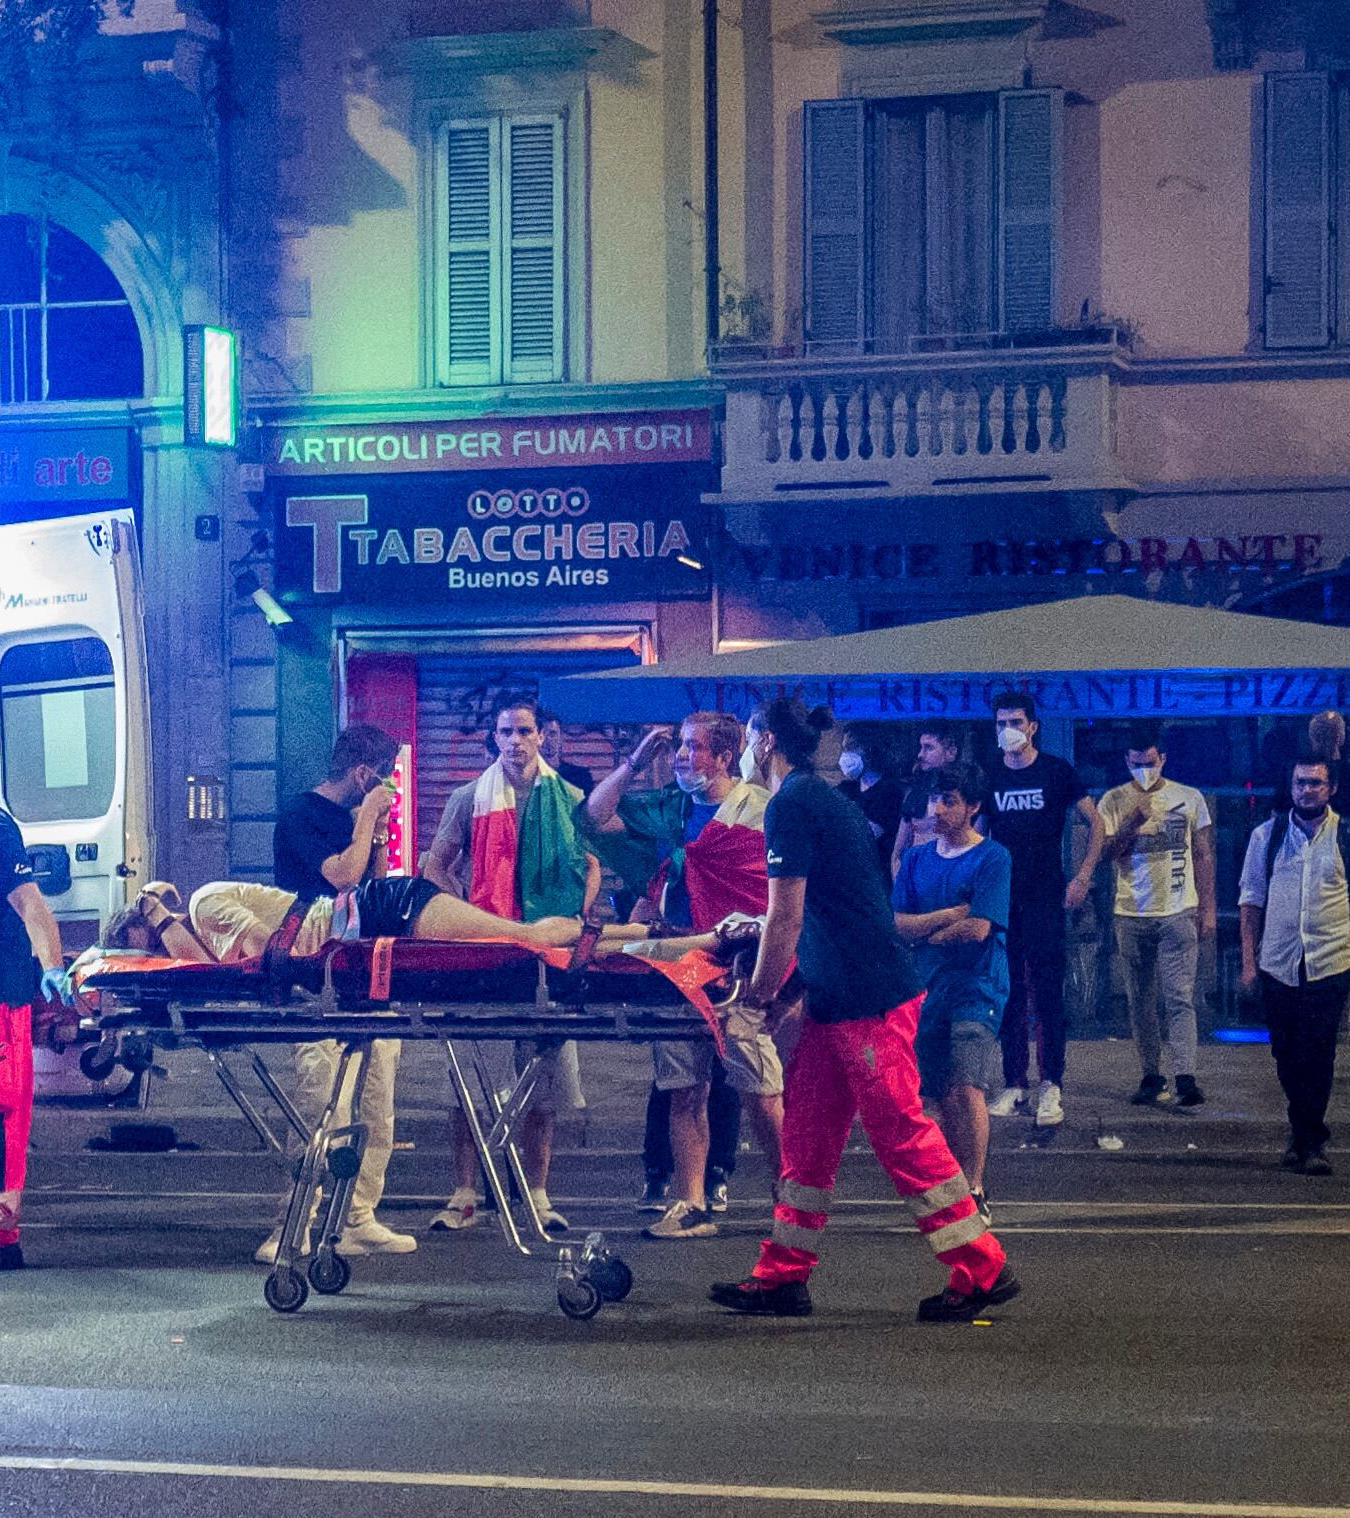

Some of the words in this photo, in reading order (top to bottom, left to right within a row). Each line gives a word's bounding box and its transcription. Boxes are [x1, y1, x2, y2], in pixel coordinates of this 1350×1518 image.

[278, 434, 428, 464] ARTICOLI
[436, 432, 503, 459] PER
[513, 422, 693, 457] FUMATORI
[33, 452, 113, 487] arte
[471, 491, 585, 516] LOTTO
[202, 518, 211, 535] 2
[348, 520, 691, 565] TABACCHERIA
[969, 535, 1323, 577] RISTORANTE
[448, 568, 539, 589] Buenos
[546, 565, 609, 587] Aires
[994, 789, 1045, 812] VANS
